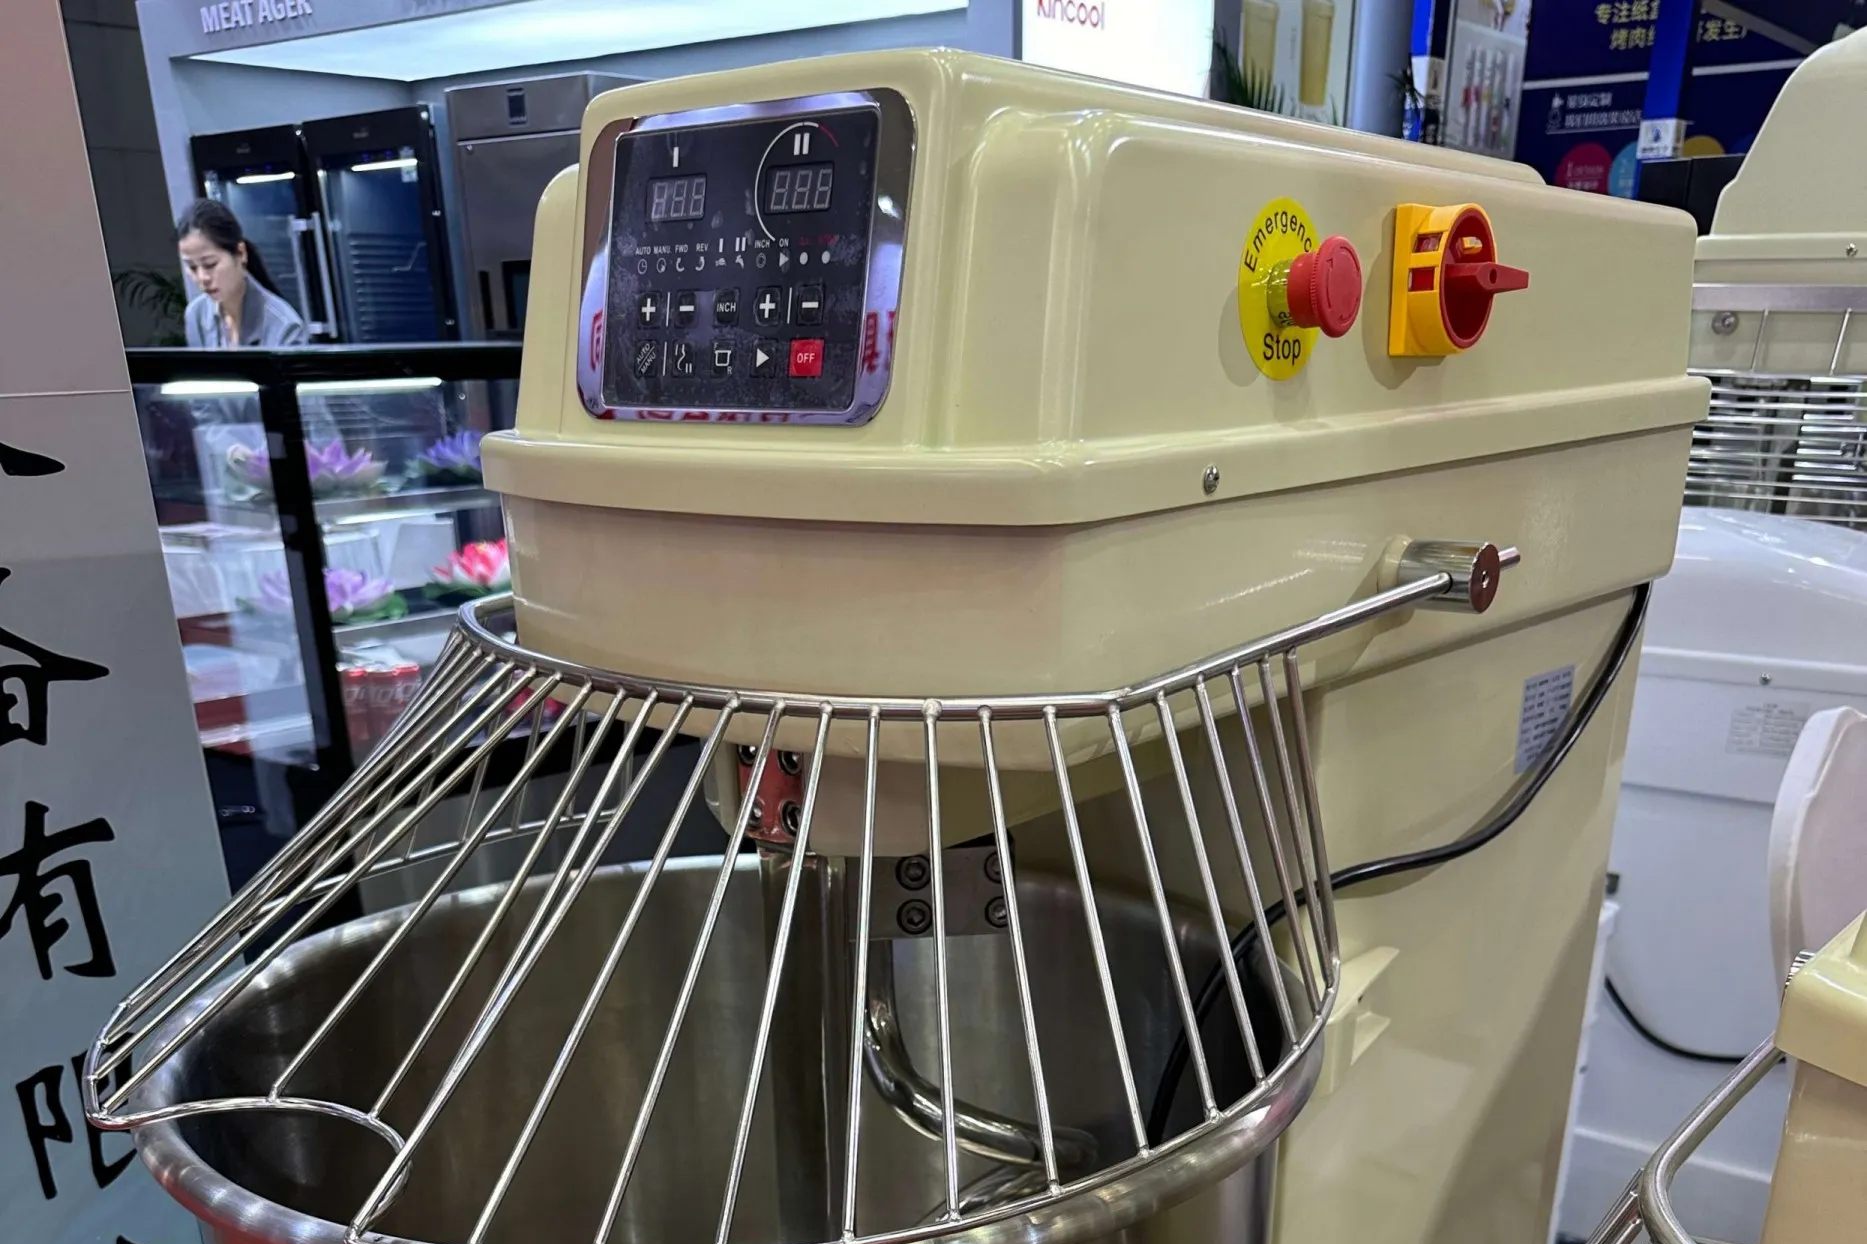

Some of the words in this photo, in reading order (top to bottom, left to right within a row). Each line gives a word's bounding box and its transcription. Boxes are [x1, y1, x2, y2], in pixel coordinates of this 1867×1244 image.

[199, 0, 254, 33] MEAT
[1036, 0, 1105, 30] Kincool
[635, 246, 652, 256] AUTO
[675, 244, 689, 253] FWD
[696, 242, 709, 252] REV
[754, 239, 771, 249] INCH
[778, 238, 790, 247] ON
[1244, 209, 1313, 273] Emergenc
[716, 302, 737, 313] INCH
[636, 343, 650, 364] AUTO
[796, 352, 816, 364] OFF
[1263, 331, 1301, 367] Stop
[640, 352, 657, 374] MANU
